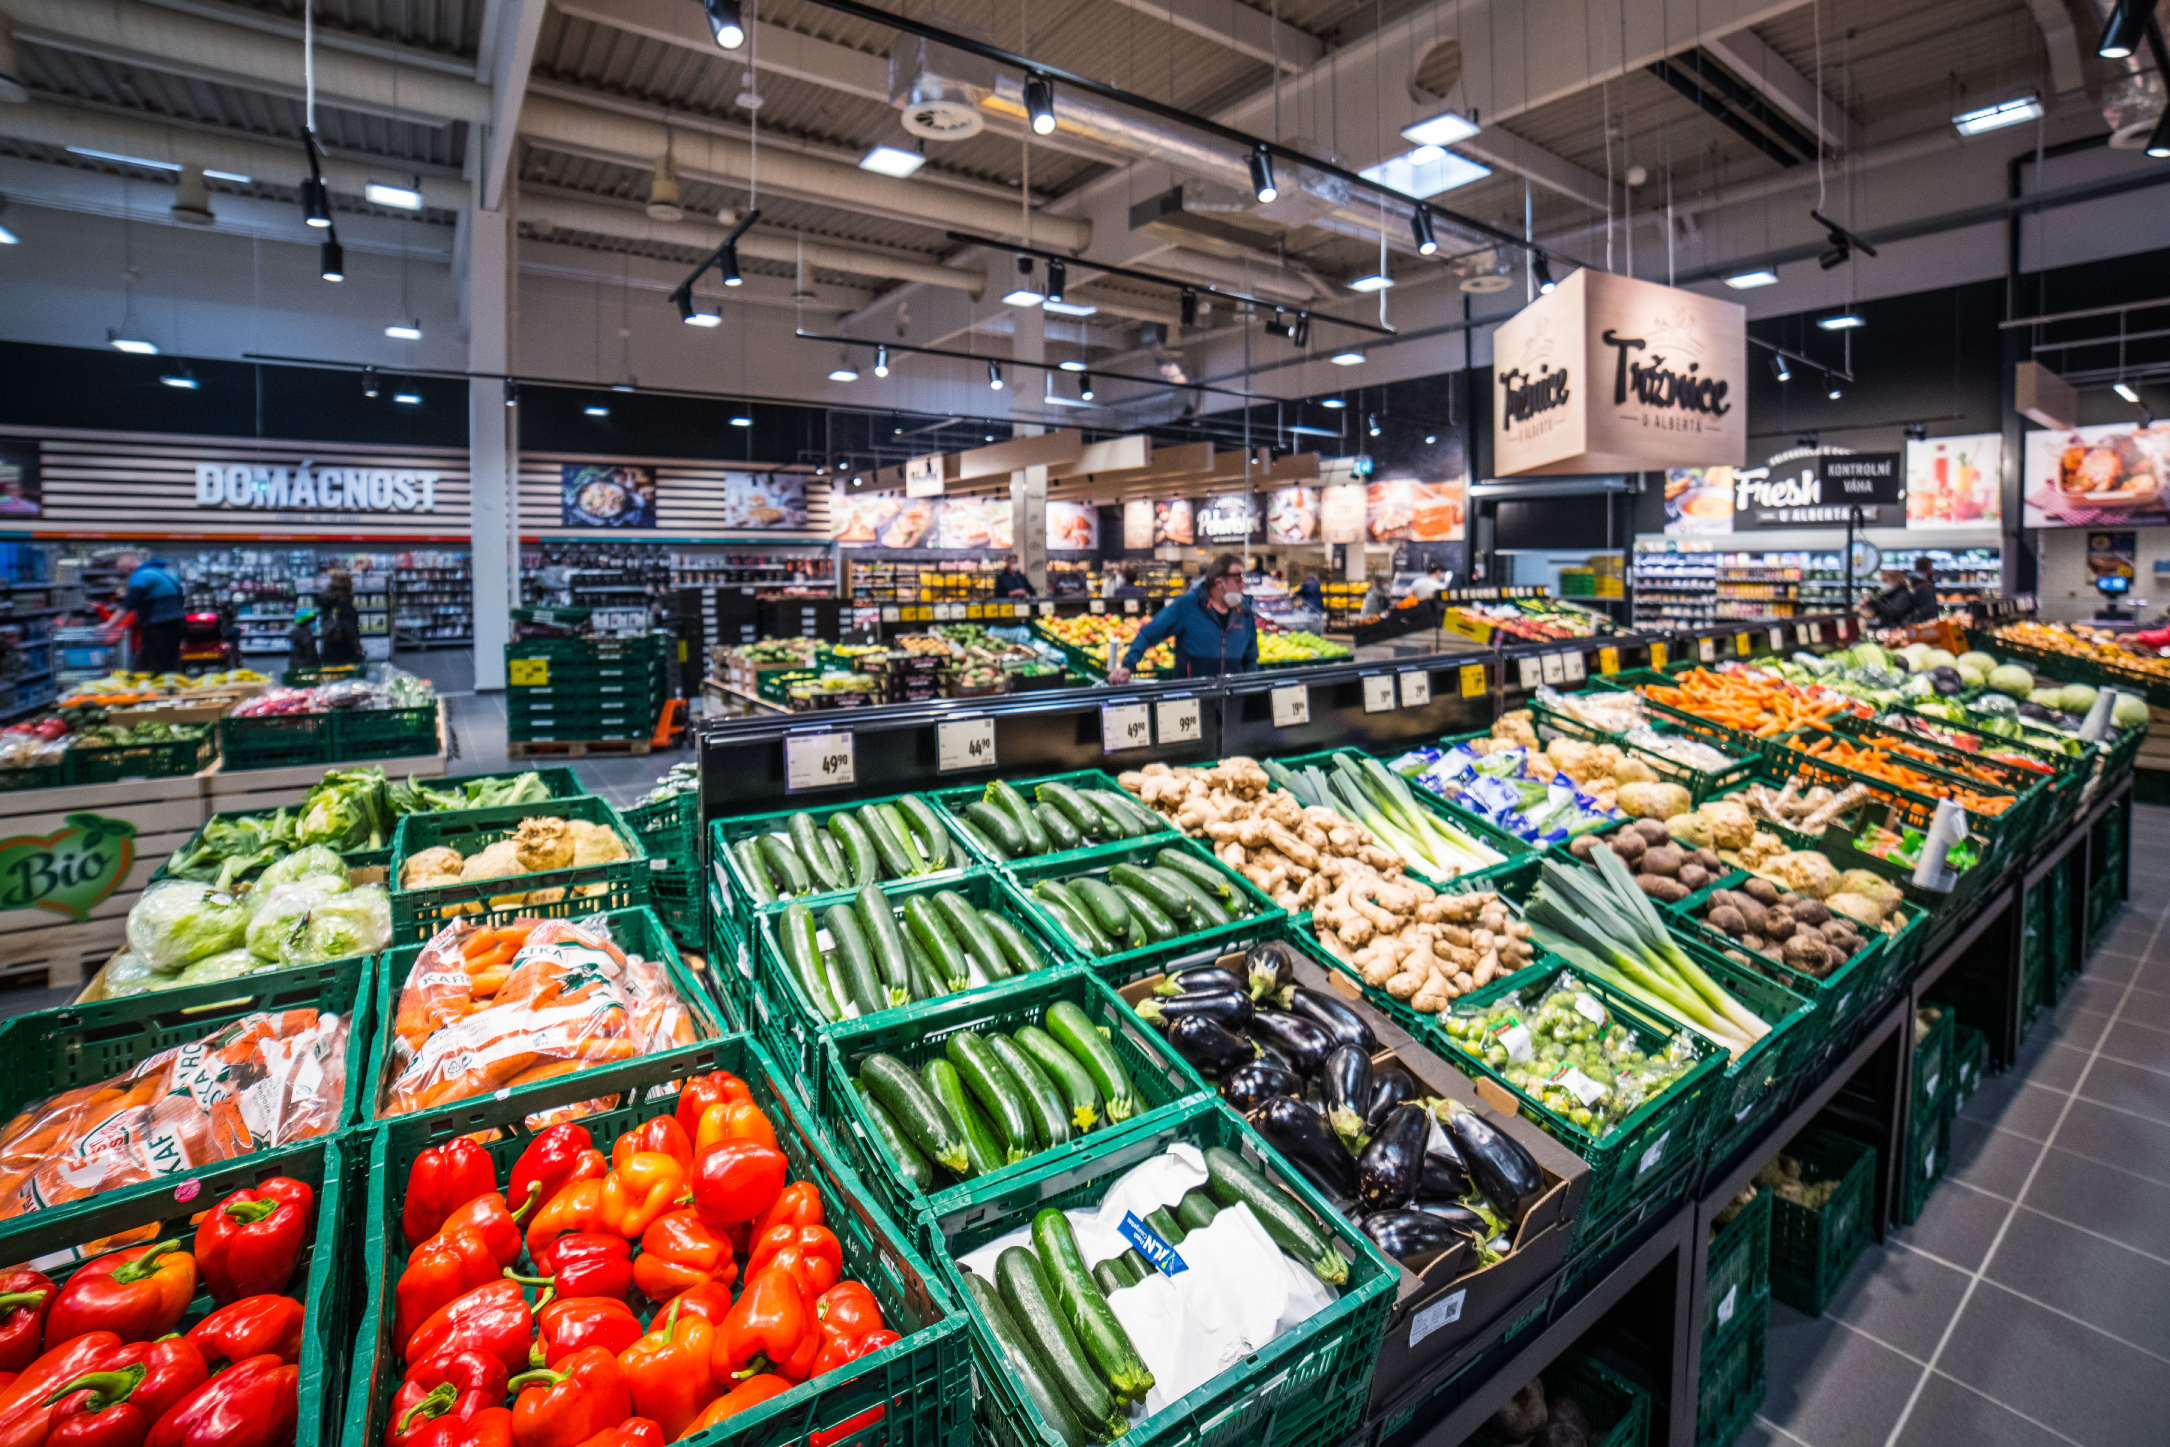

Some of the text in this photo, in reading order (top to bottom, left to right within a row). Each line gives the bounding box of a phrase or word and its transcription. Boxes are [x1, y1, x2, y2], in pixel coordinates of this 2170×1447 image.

[1602, 329, 1731, 416] Tržnice
[1654, 416, 1702, 432] ALBERTA
[195, 459, 440, 510] DOMÁCNOST
[1732, 467, 1821, 511] Fresh
[1827, 461, 1892, 476] KONTROLNÍ
[1843, 480, 1874, 493] VÁHA
[2, 852, 112, 905] Bio
